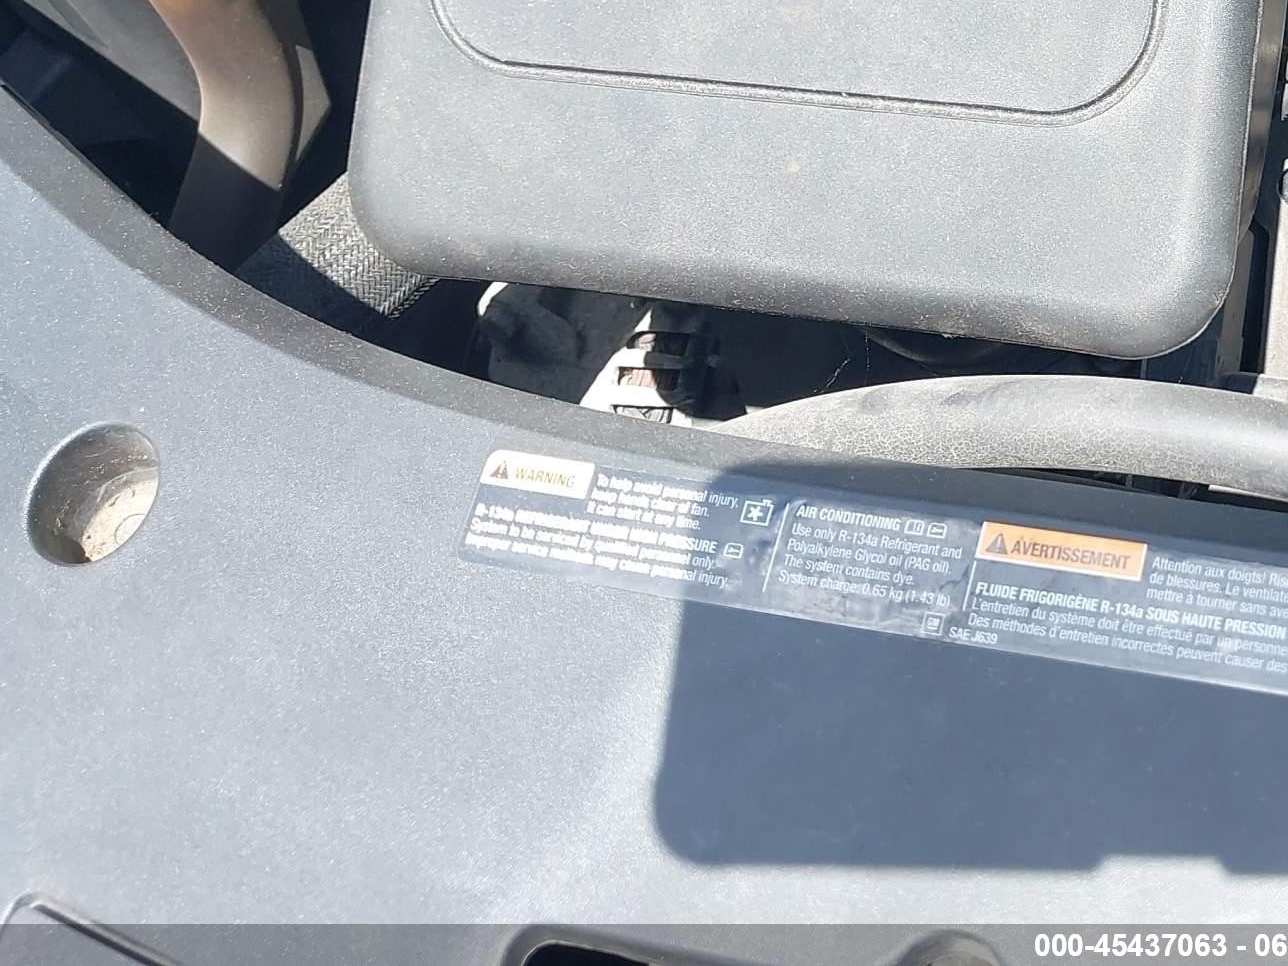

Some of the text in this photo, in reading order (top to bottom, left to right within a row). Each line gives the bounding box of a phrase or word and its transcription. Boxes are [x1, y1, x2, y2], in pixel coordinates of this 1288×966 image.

[515, 467, 576, 489] WARNING
[597, 473, 610, 488] To
[609, 476, 633, 493] help
[661, 486, 708, 504] personal
[708, 493, 739, 509] injury,
[595, 504, 617, 517] can
[675, 515, 701, 531] time.
[690, 502, 710, 517] fan.
[795, 505, 901, 532] AIR CONDITIONING
[470, 516, 509, 535] System
[691, 557, 715, 571] only.
[658, 533, 719, 554] PRESSURE
[786, 538, 951, 574] Polyalkylene Glycol oil (PAG oil).
[791, 523, 963, 559] Use only R-134a Refrigerant and
[1010, 538, 1132, 570] AVERTISSEMENT
[650, 564, 697, 583] personal
[697, 573, 729, 588] injury.
[784, 554, 915, 586] The system contains dye.
[1149, 571, 1165, 585] de
[1166, 573, 1222, 594] blessures.
[1225, 581, 1241, 595] Le
[1151, 556, 1203, 575] Attention
[1204, 566, 1225, 579] aux
[1227, 566, 1267, 585] doigts!
[778, 569, 819, 586] System
[862, 585, 888, 598] 0.65
[888, 587, 904, 604] kg
[905, 590, 934, 605] (1.43
[936, 593, 951, 608] lb)
[1146, 587, 1184, 603] mettre
[1185, 591, 1194, 604] à
[1195, 593, 1239, 611] tourner
[1239, 601, 1268, 616] sans
[975, 581, 1287, 640] FLUIDE FRIGORIGÈNE R-134a SOUS HAUTE PRESSION
[1031, 604, 1047, 621] du
[1049, 610, 1096, 628] système
[1097, 616, 1119, 632] doit
[1120, 620, 1144, 636] être
[1146, 624, 1193, 642] effectué
[1194, 633, 1216, 646] par
[948, 626, 999, 645] SAE J639
[967, 612, 990, 627] Des
[991, 617, 1046, 638] méthodes
[1111, 636, 1175, 656] incorrectes
[1175, 645, 1222, 664] peuvent
[1224, 653, 1265, 668] causer
[1266, 659, 1288, 673] des
